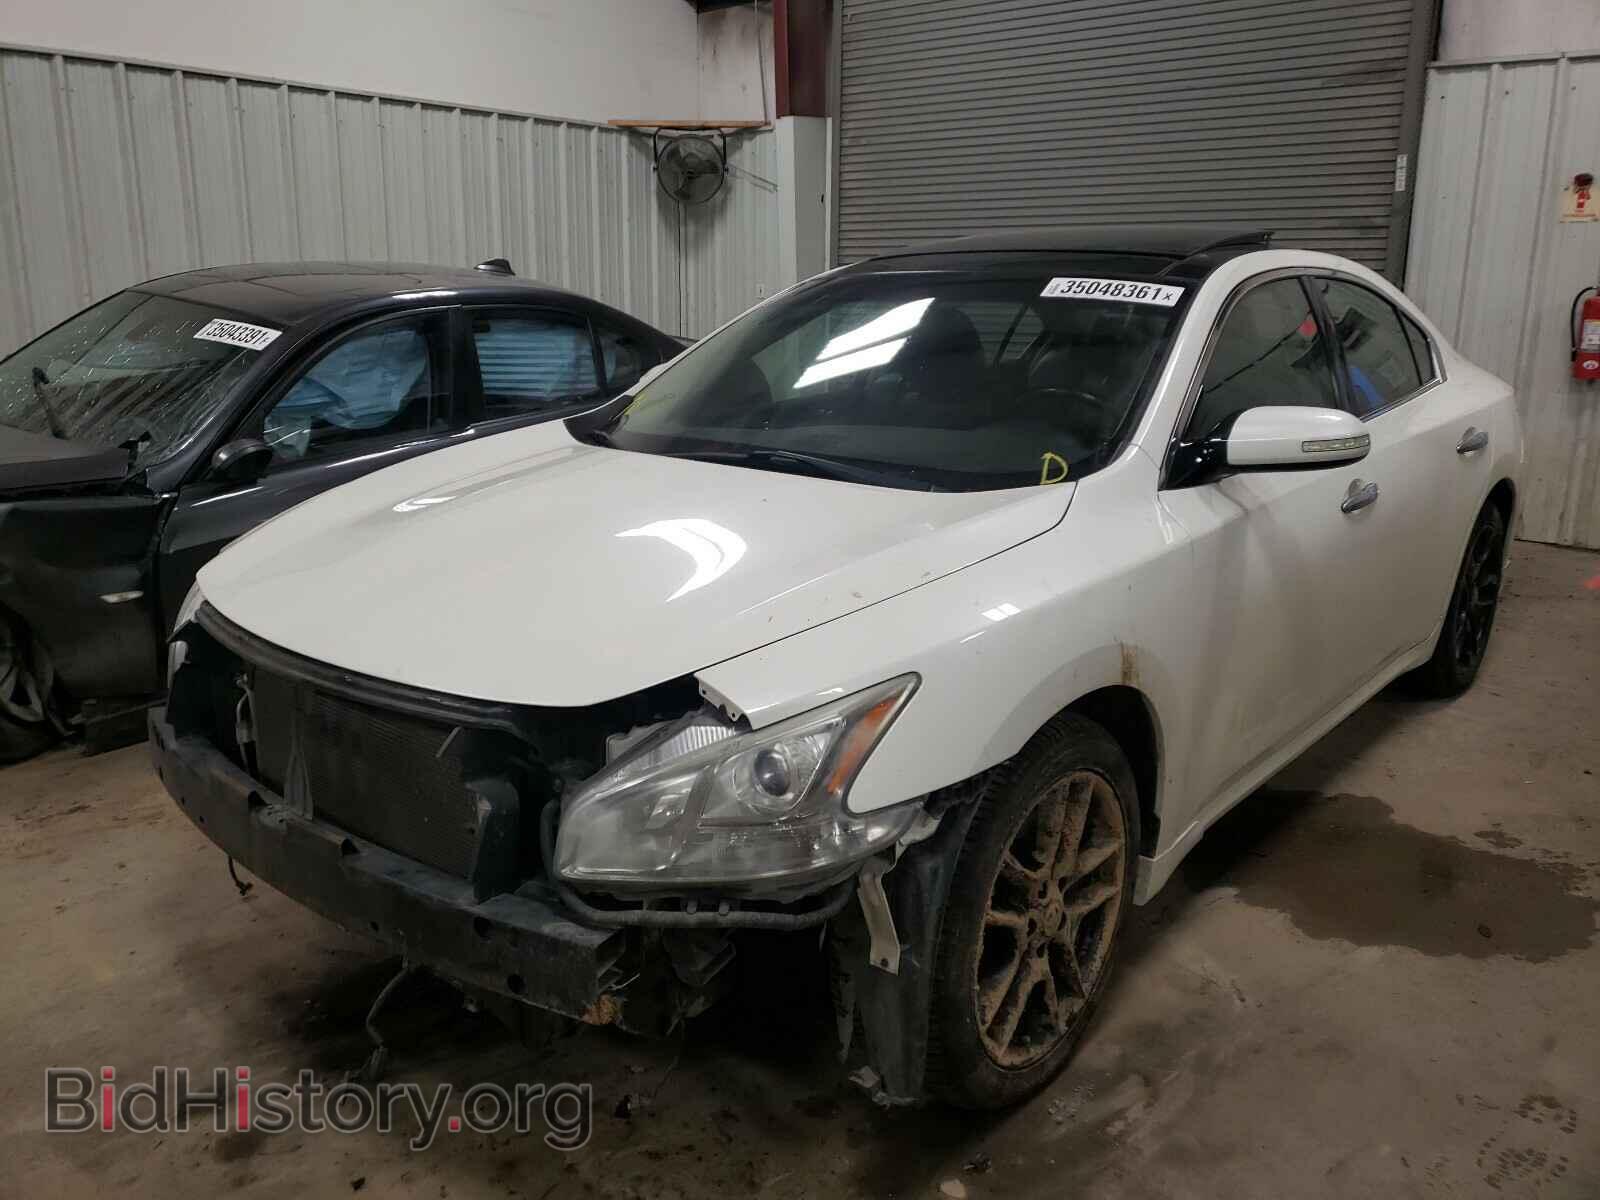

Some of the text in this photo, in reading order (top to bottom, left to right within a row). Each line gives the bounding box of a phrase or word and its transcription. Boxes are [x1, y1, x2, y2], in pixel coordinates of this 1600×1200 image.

[1060, 280, 1162, 300] 35048361
[206, 322, 268, 345] 35043391
[1040, 452, 1068, 485] D
